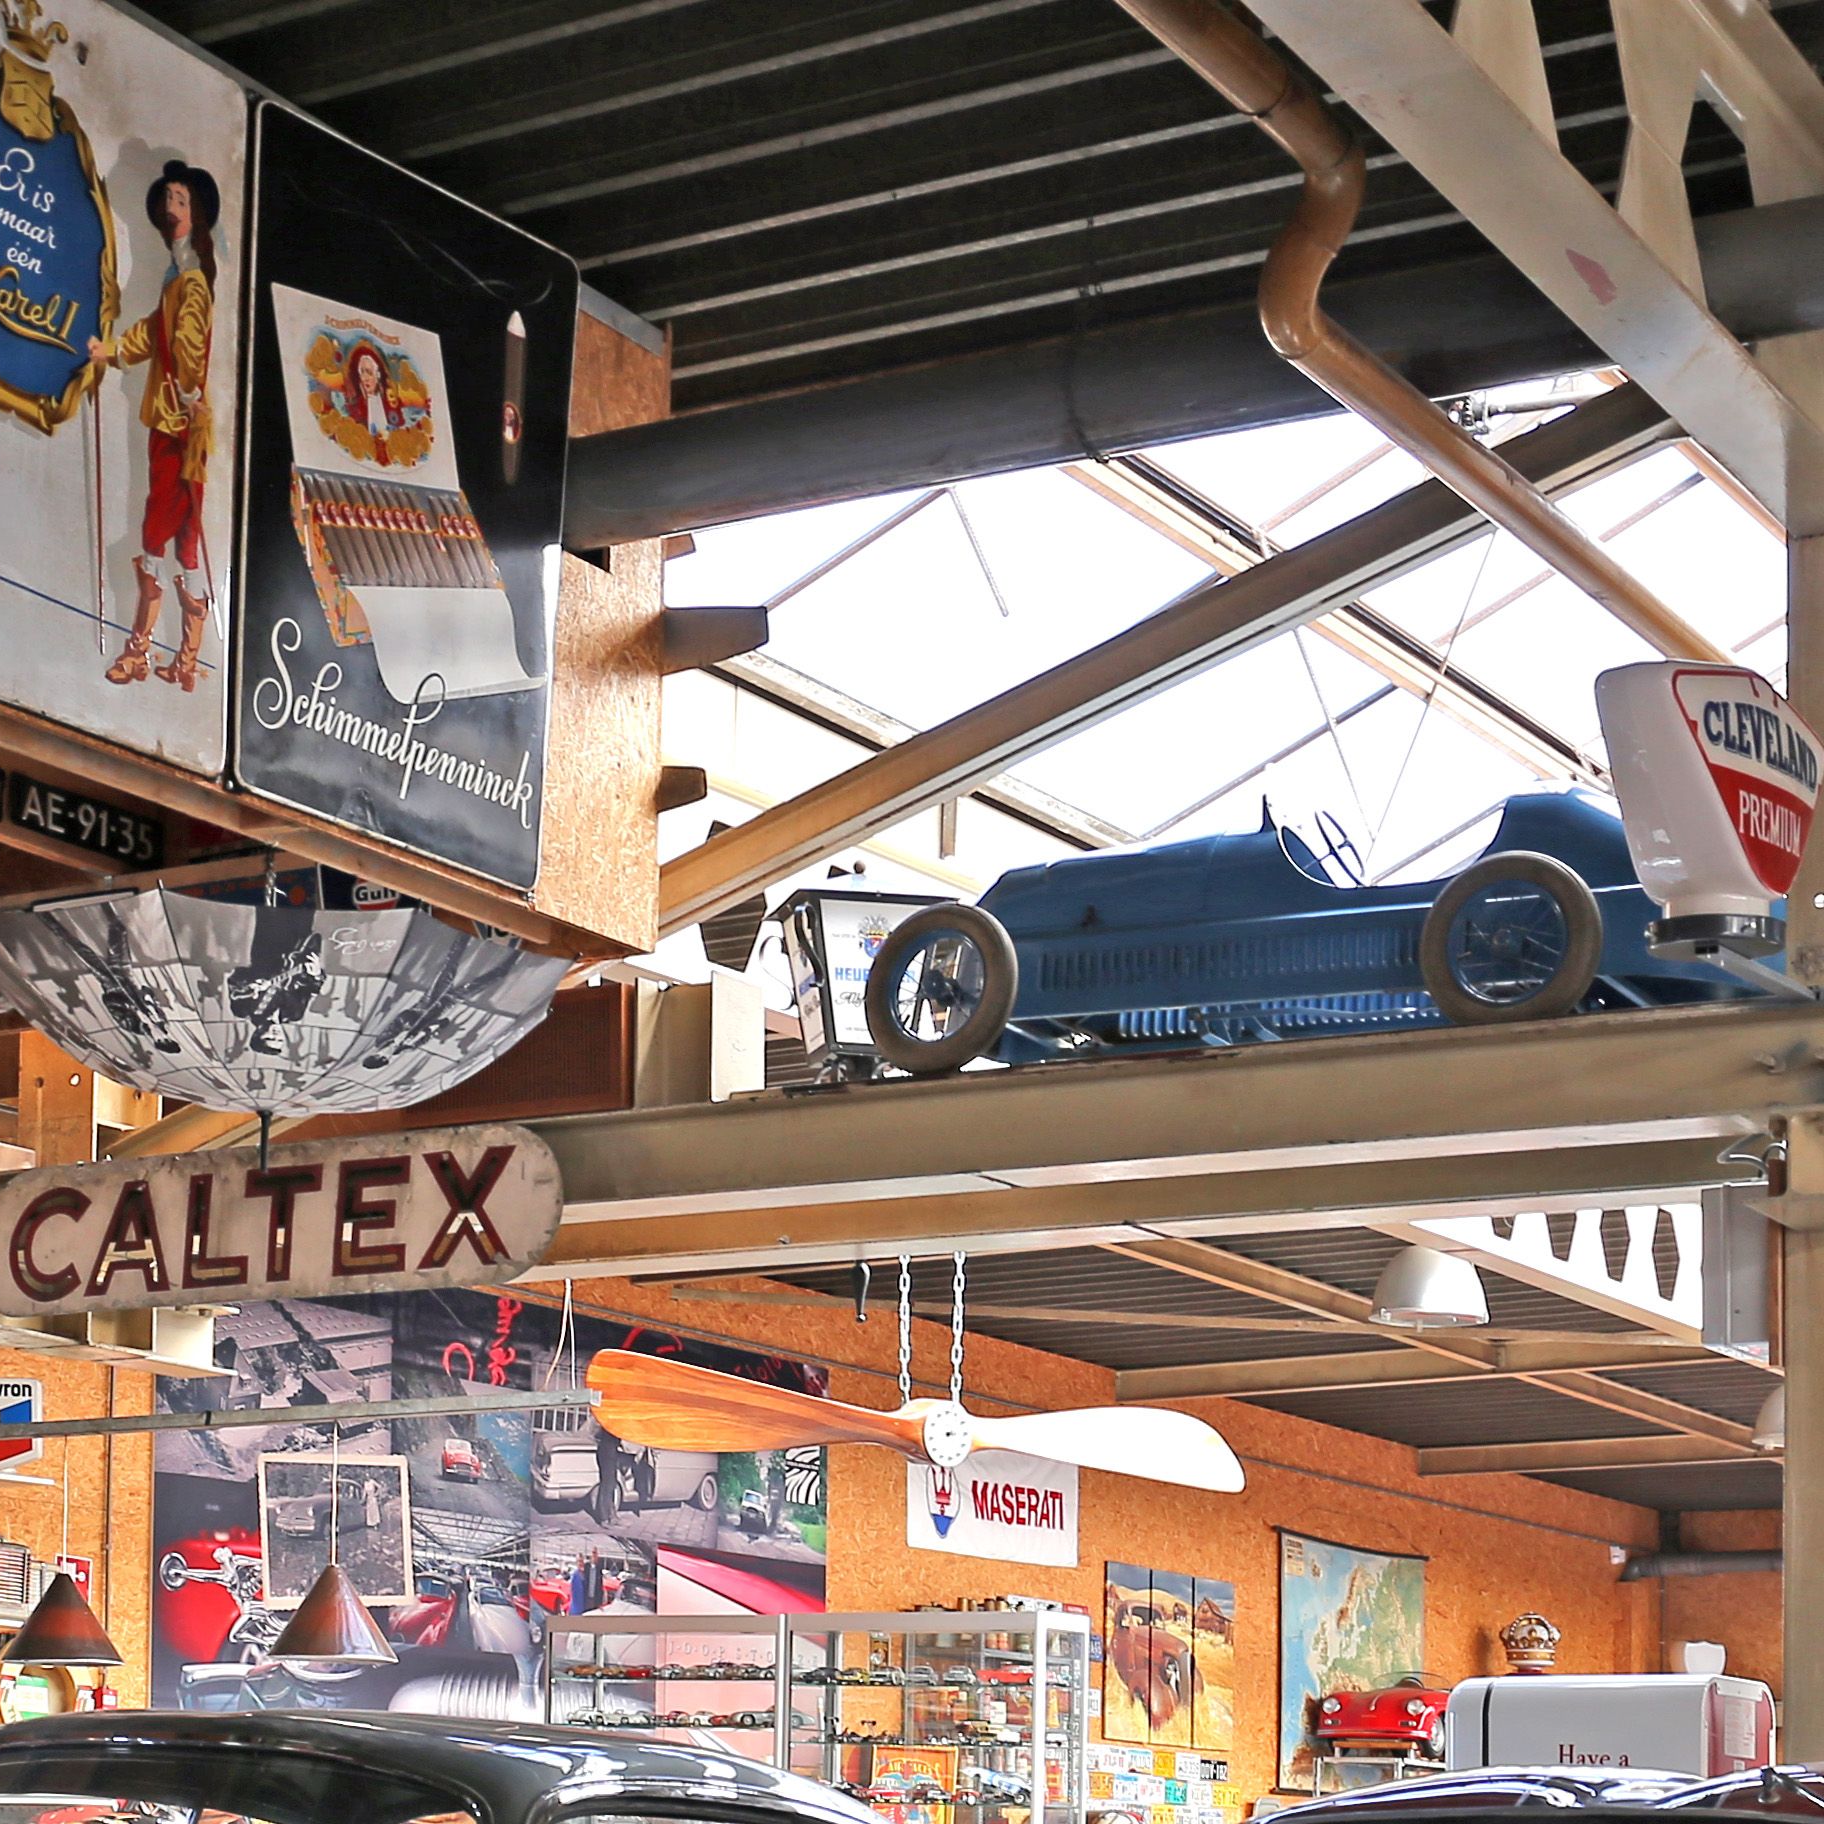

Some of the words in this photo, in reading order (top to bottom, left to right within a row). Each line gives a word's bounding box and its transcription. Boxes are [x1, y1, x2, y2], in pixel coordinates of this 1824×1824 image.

[252, 617, 533, 830] Schimmelpenninck
[1703, 700, 1819, 791] CLEVELAND
[21, 784, 154, 861] AE-91-35
[1739, 789, 1801, 857] PREMIUM
[9, 1145, 518, 1302] CALTEX
[971, 1480, 1064, 1531] MASERATI
[1557, 1743, 1611, 1767] Have
